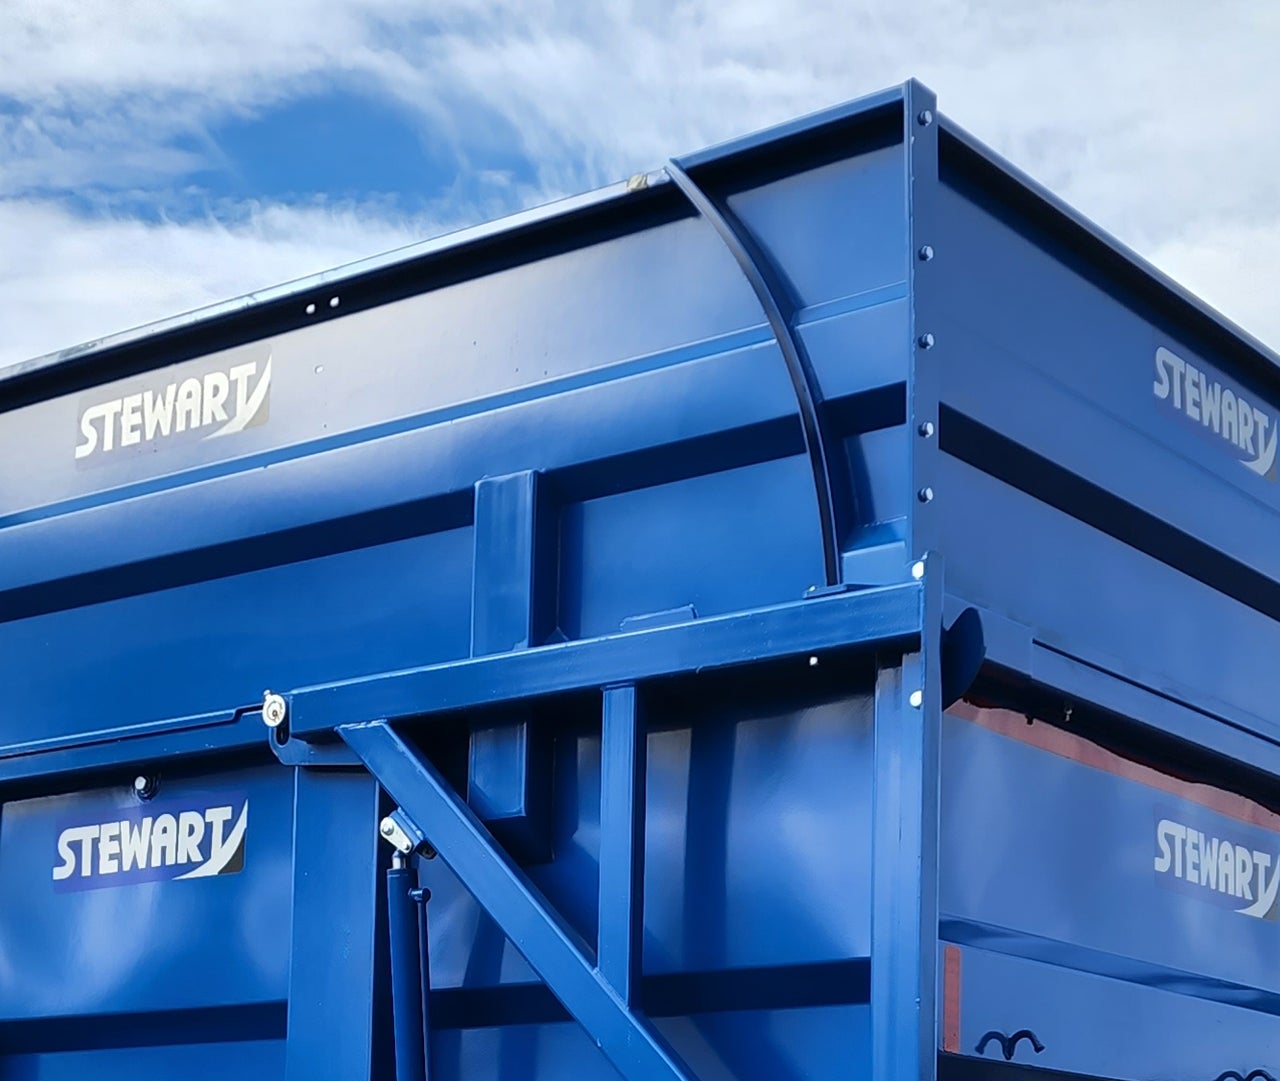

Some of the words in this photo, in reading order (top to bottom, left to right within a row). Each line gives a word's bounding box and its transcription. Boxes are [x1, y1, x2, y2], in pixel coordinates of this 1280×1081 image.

[75, 353, 272, 459] STEWART
[1154, 346, 1278, 477] STEWART
[53, 799, 248, 881] STEWART
[1154, 819, 1280, 919] STEWART
